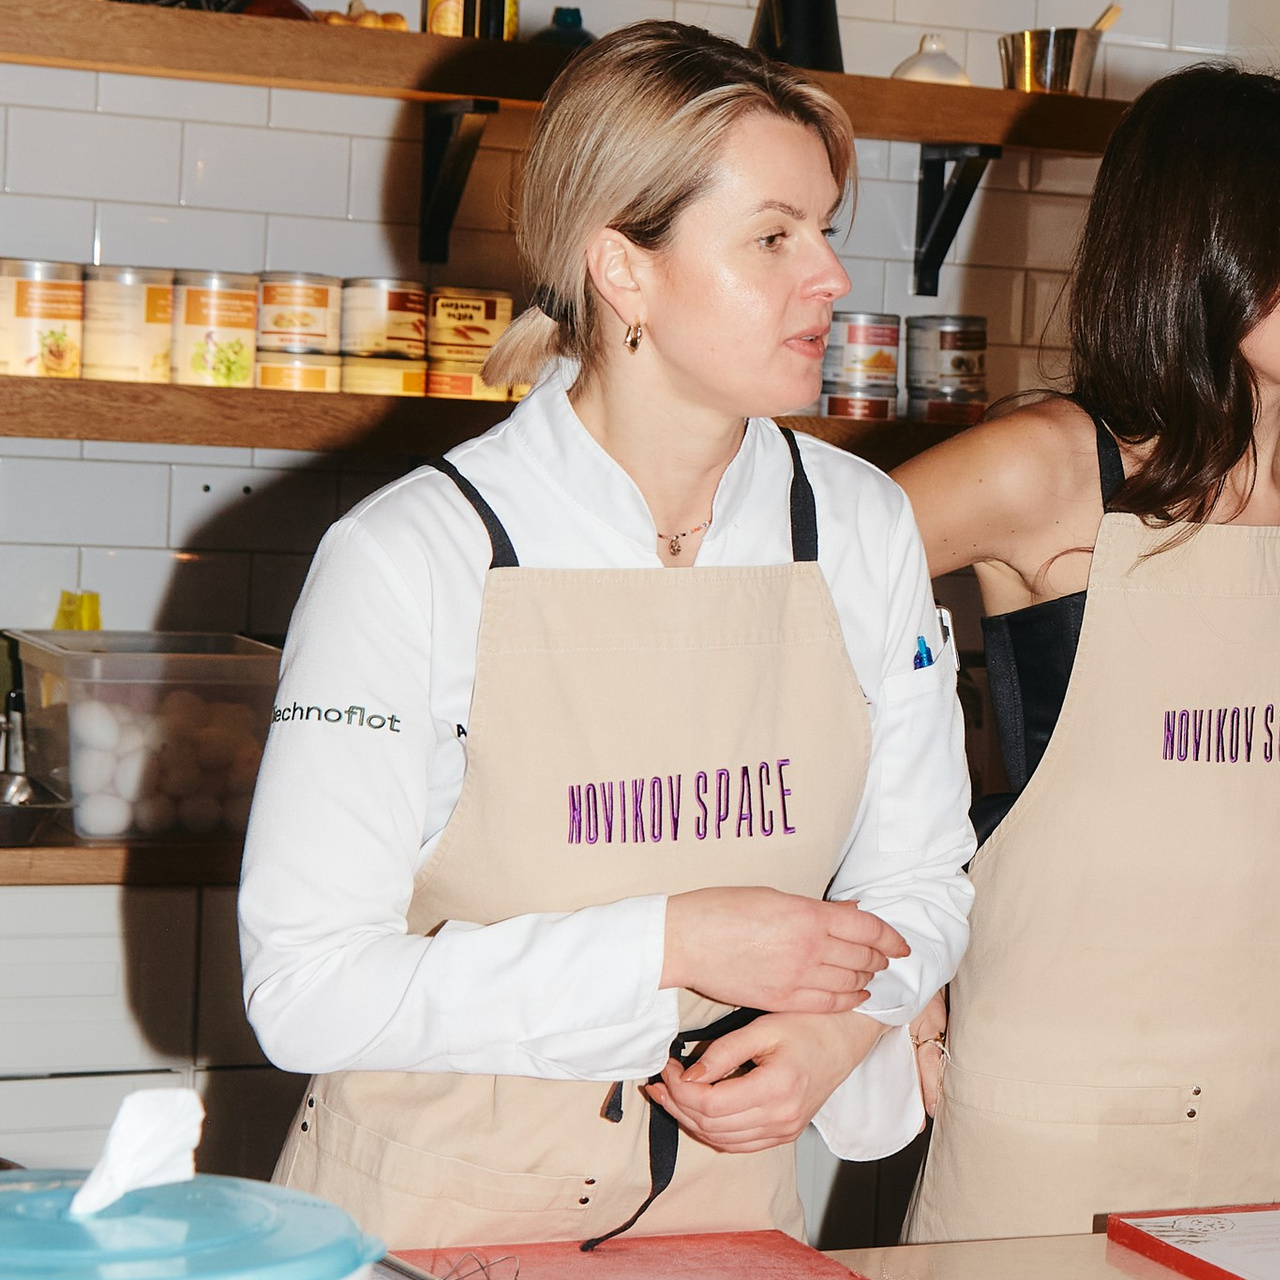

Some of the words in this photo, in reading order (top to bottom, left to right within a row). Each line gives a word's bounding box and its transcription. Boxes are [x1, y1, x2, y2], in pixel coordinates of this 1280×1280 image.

[1163, 706, 1256, 763] NOVIKOV
[568, 774, 681, 844] NOVIKOV
[694, 759, 796, 840] SPACE
